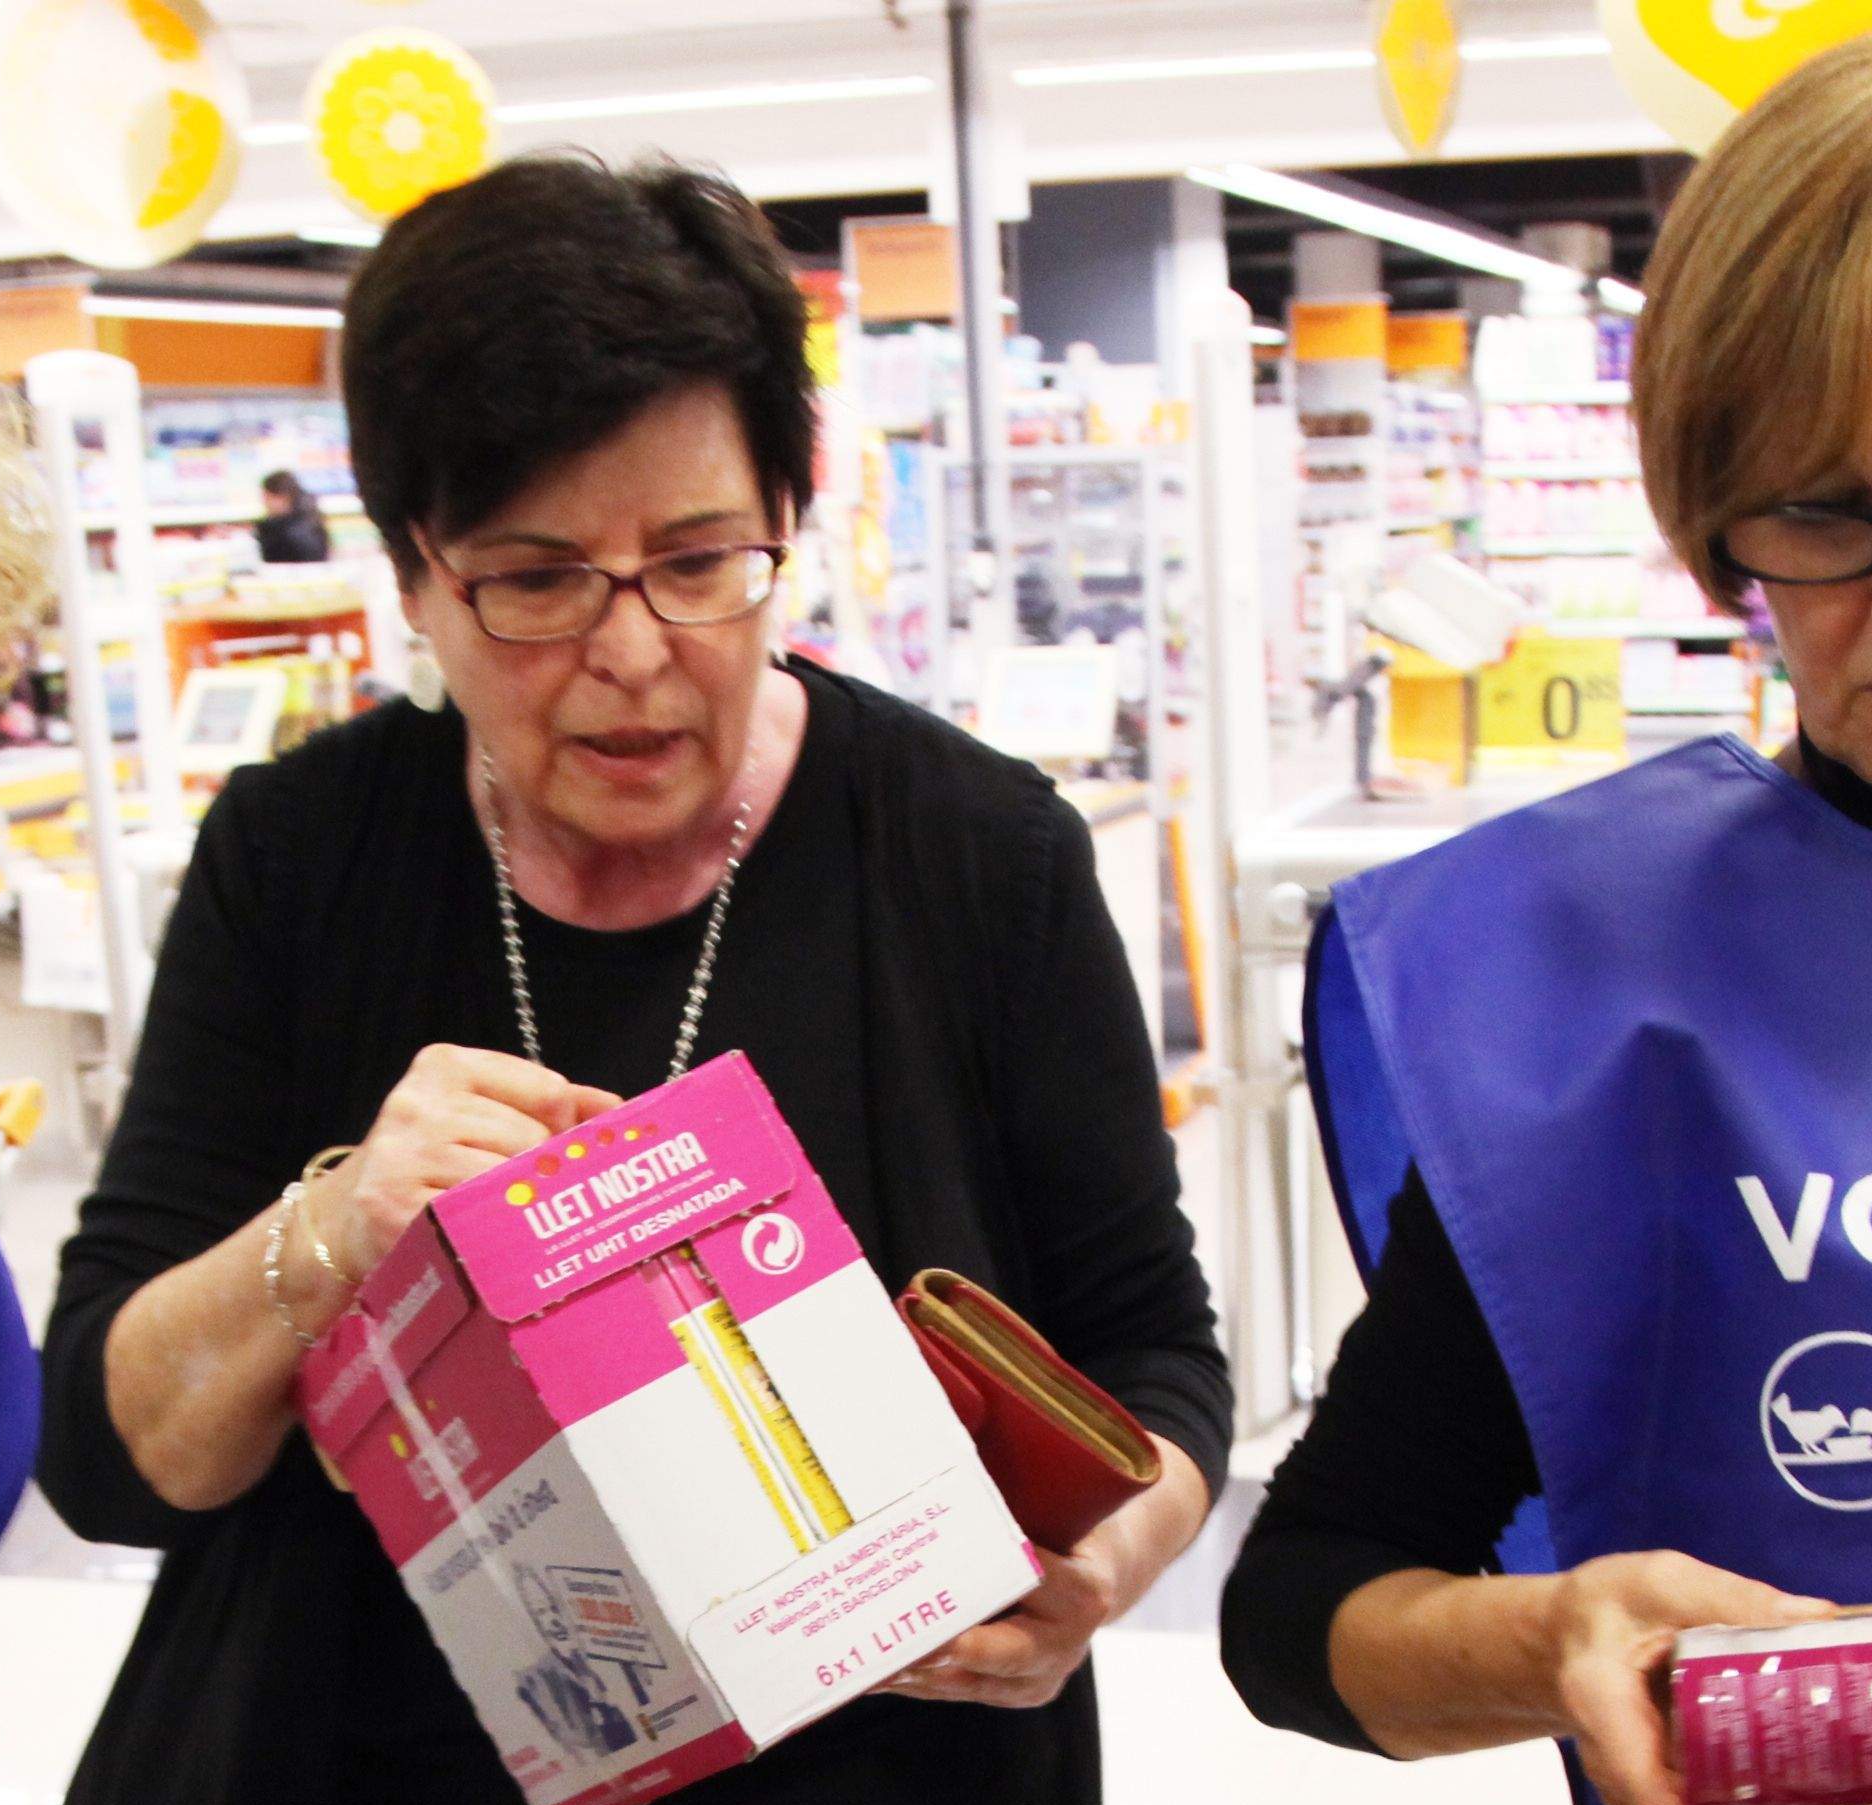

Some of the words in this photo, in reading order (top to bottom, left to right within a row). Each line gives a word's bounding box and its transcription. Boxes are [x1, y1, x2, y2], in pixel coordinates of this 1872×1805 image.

[1542, 676, 1580, 740] 0
[523, 1182, 594, 1240] LLET
[588, 1131, 708, 1210] NOSTRA
[532, 1254, 585, 1290] LLET
[584, 1231, 630, 1264] UHT
[628, 1177, 748, 1243] DESNATADA
[773, 1570, 832, 1608] NOSTRA
[840, 1559, 925, 1616] BARCELONA
[816, 1646, 866, 1687] 6x1
[871, 1588, 959, 1653] LITRE
